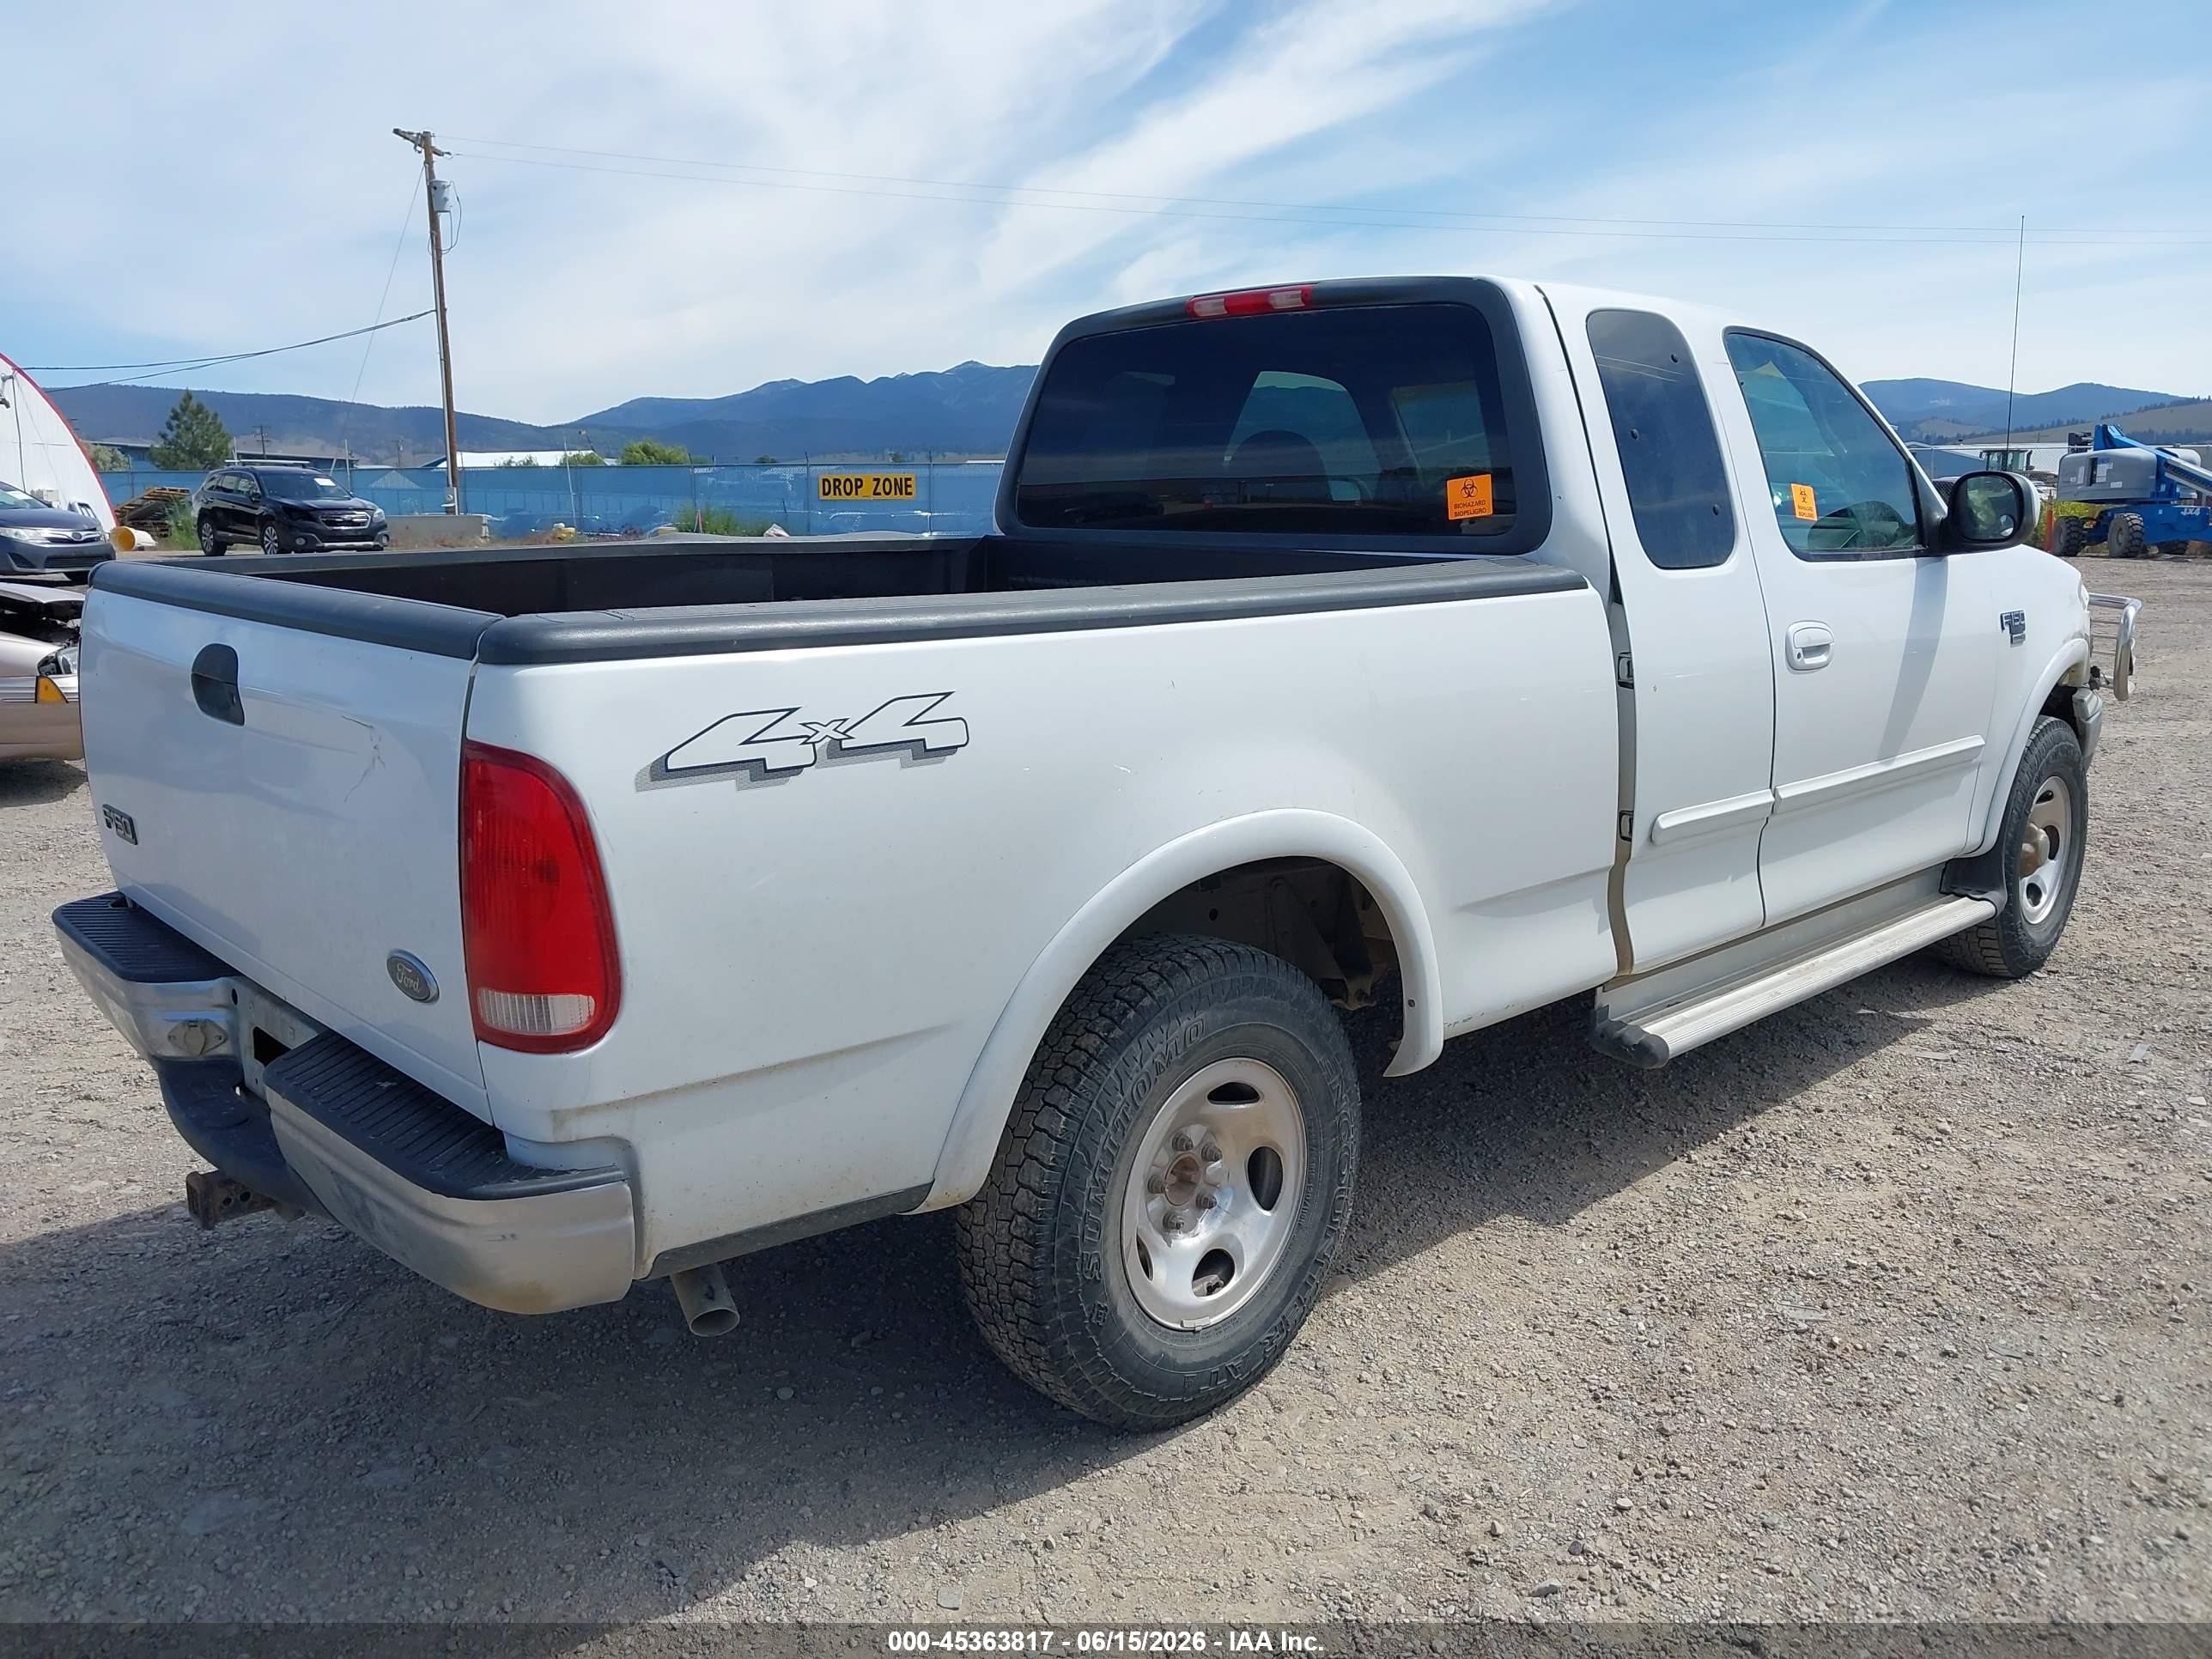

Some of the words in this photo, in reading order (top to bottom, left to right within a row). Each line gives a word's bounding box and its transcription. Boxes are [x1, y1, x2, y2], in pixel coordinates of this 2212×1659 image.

[822, 477, 864, 496] DROP
[872, 477, 914, 496] ZONE
[1454, 500, 1486, 509] BIOHAZARD
[396, 962, 421, 994] Ford
[1081, 1018, 1204, 1280] SUMITOMO
